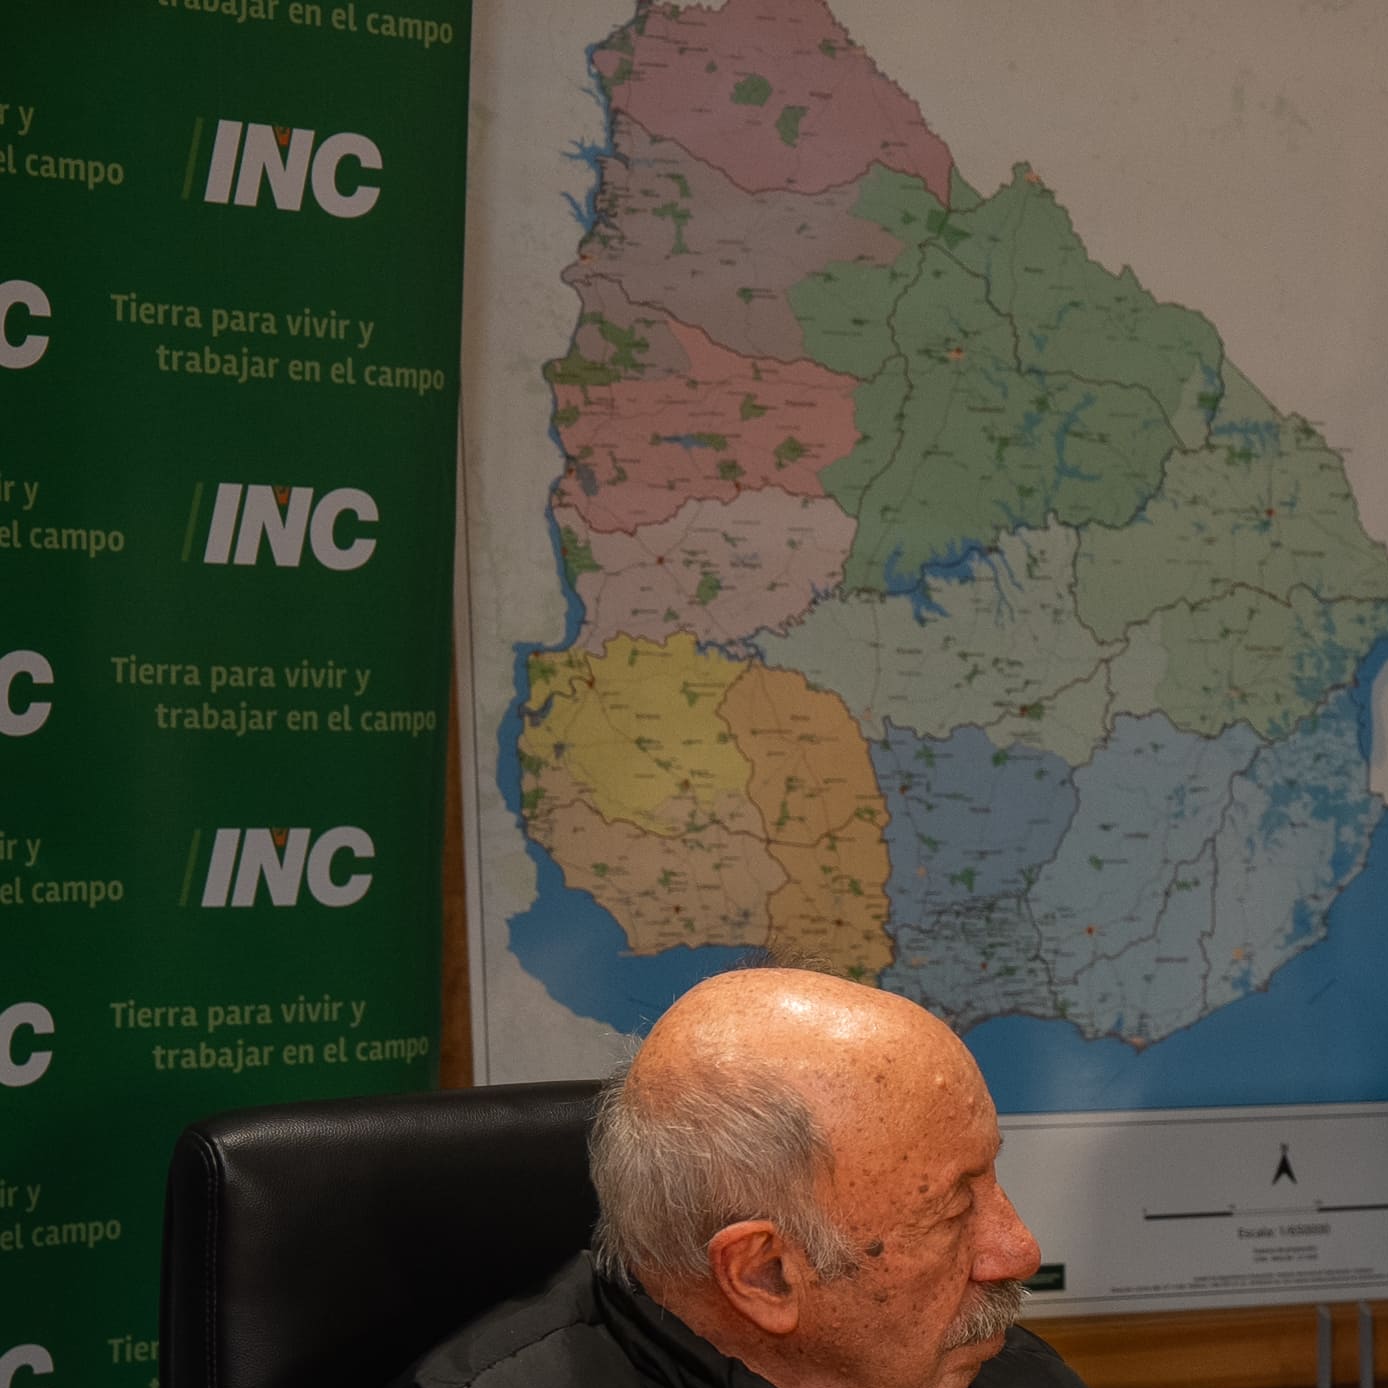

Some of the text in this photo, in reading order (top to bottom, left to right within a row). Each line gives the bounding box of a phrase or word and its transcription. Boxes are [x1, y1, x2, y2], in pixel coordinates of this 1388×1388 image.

[288, 2, 322, 27] en
[331, 2, 358, 32] el
[366, 12, 453, 49] campo
[17, 105, 35, 136] y
[25, 153, 125, 191] campo
[204, 119, 383, 219] INC
[110, 292, 375, 350] Tierra para vivir y
[155, 344, 445, 396] trabajar en el campo
[22, 481, 39, 511] y
[29, 527, 125, 559] campo
[203, 482, 379, 571] INC
[110, 654, 371, 697] Tierra para vivir y
[154, 701, 437, 737] trabajar en el campo
[24, 838, 41, 868] y
[201, 826, 376, 908] INC
[31, 879, 124, 909] campo
[110, 993, 366, 1033] Tierra para vivir y
[152, 1036, 429, 1074] trabajar en el campo
[25, 1184, 41, 1213] y
[31, 1219, 122, 1249] campo
[107, 1334, 160, 1364] Tier
